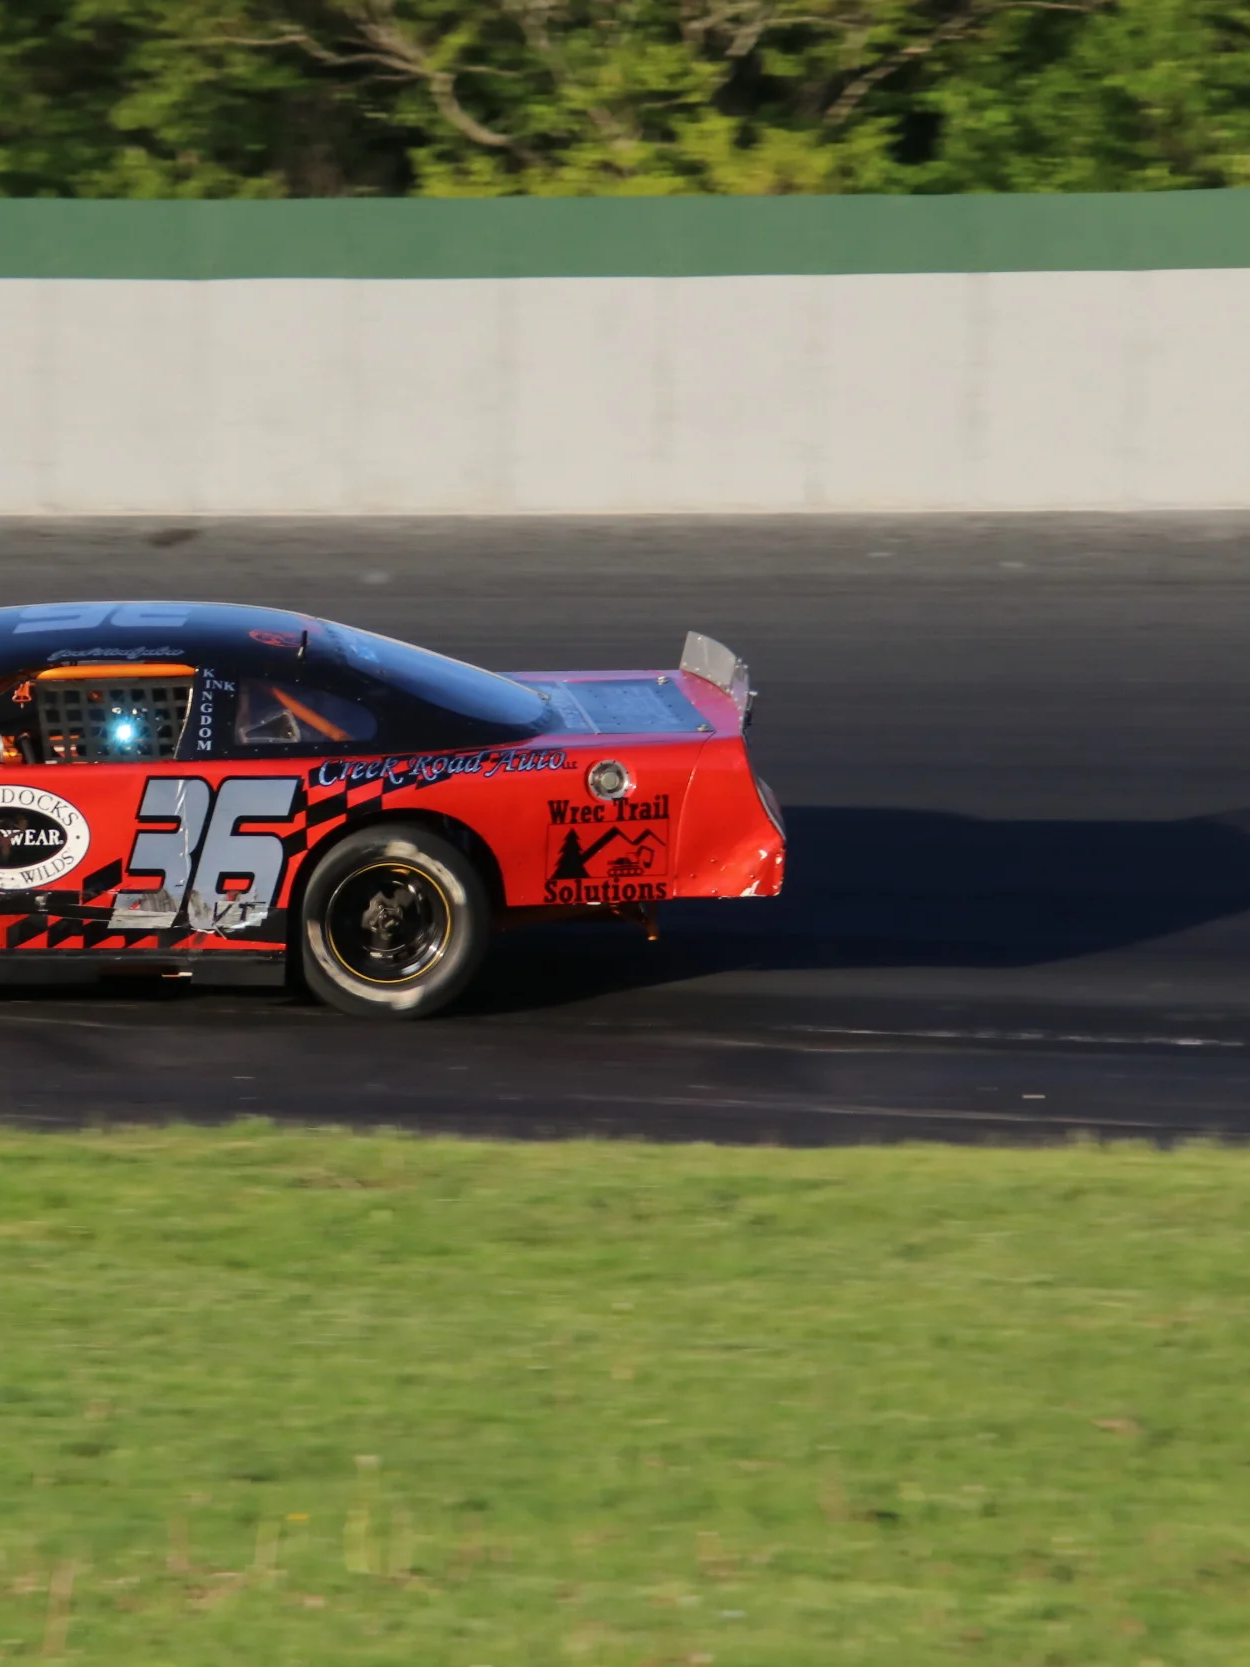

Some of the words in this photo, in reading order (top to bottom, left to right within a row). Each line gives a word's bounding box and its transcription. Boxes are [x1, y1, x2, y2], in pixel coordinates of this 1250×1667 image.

[318, 757, 403, 786] Creek
[406, 754, 482, 777] Road
[484, 750, 567, 777] Auto
[548, 800, 604, 824] Wrec
[612, 795, 669, 821] Trail
[19, 851, 75, 884] WILDS
[108, 775, 302, 930] 36
[544, 877, 667, 903] Solutions
